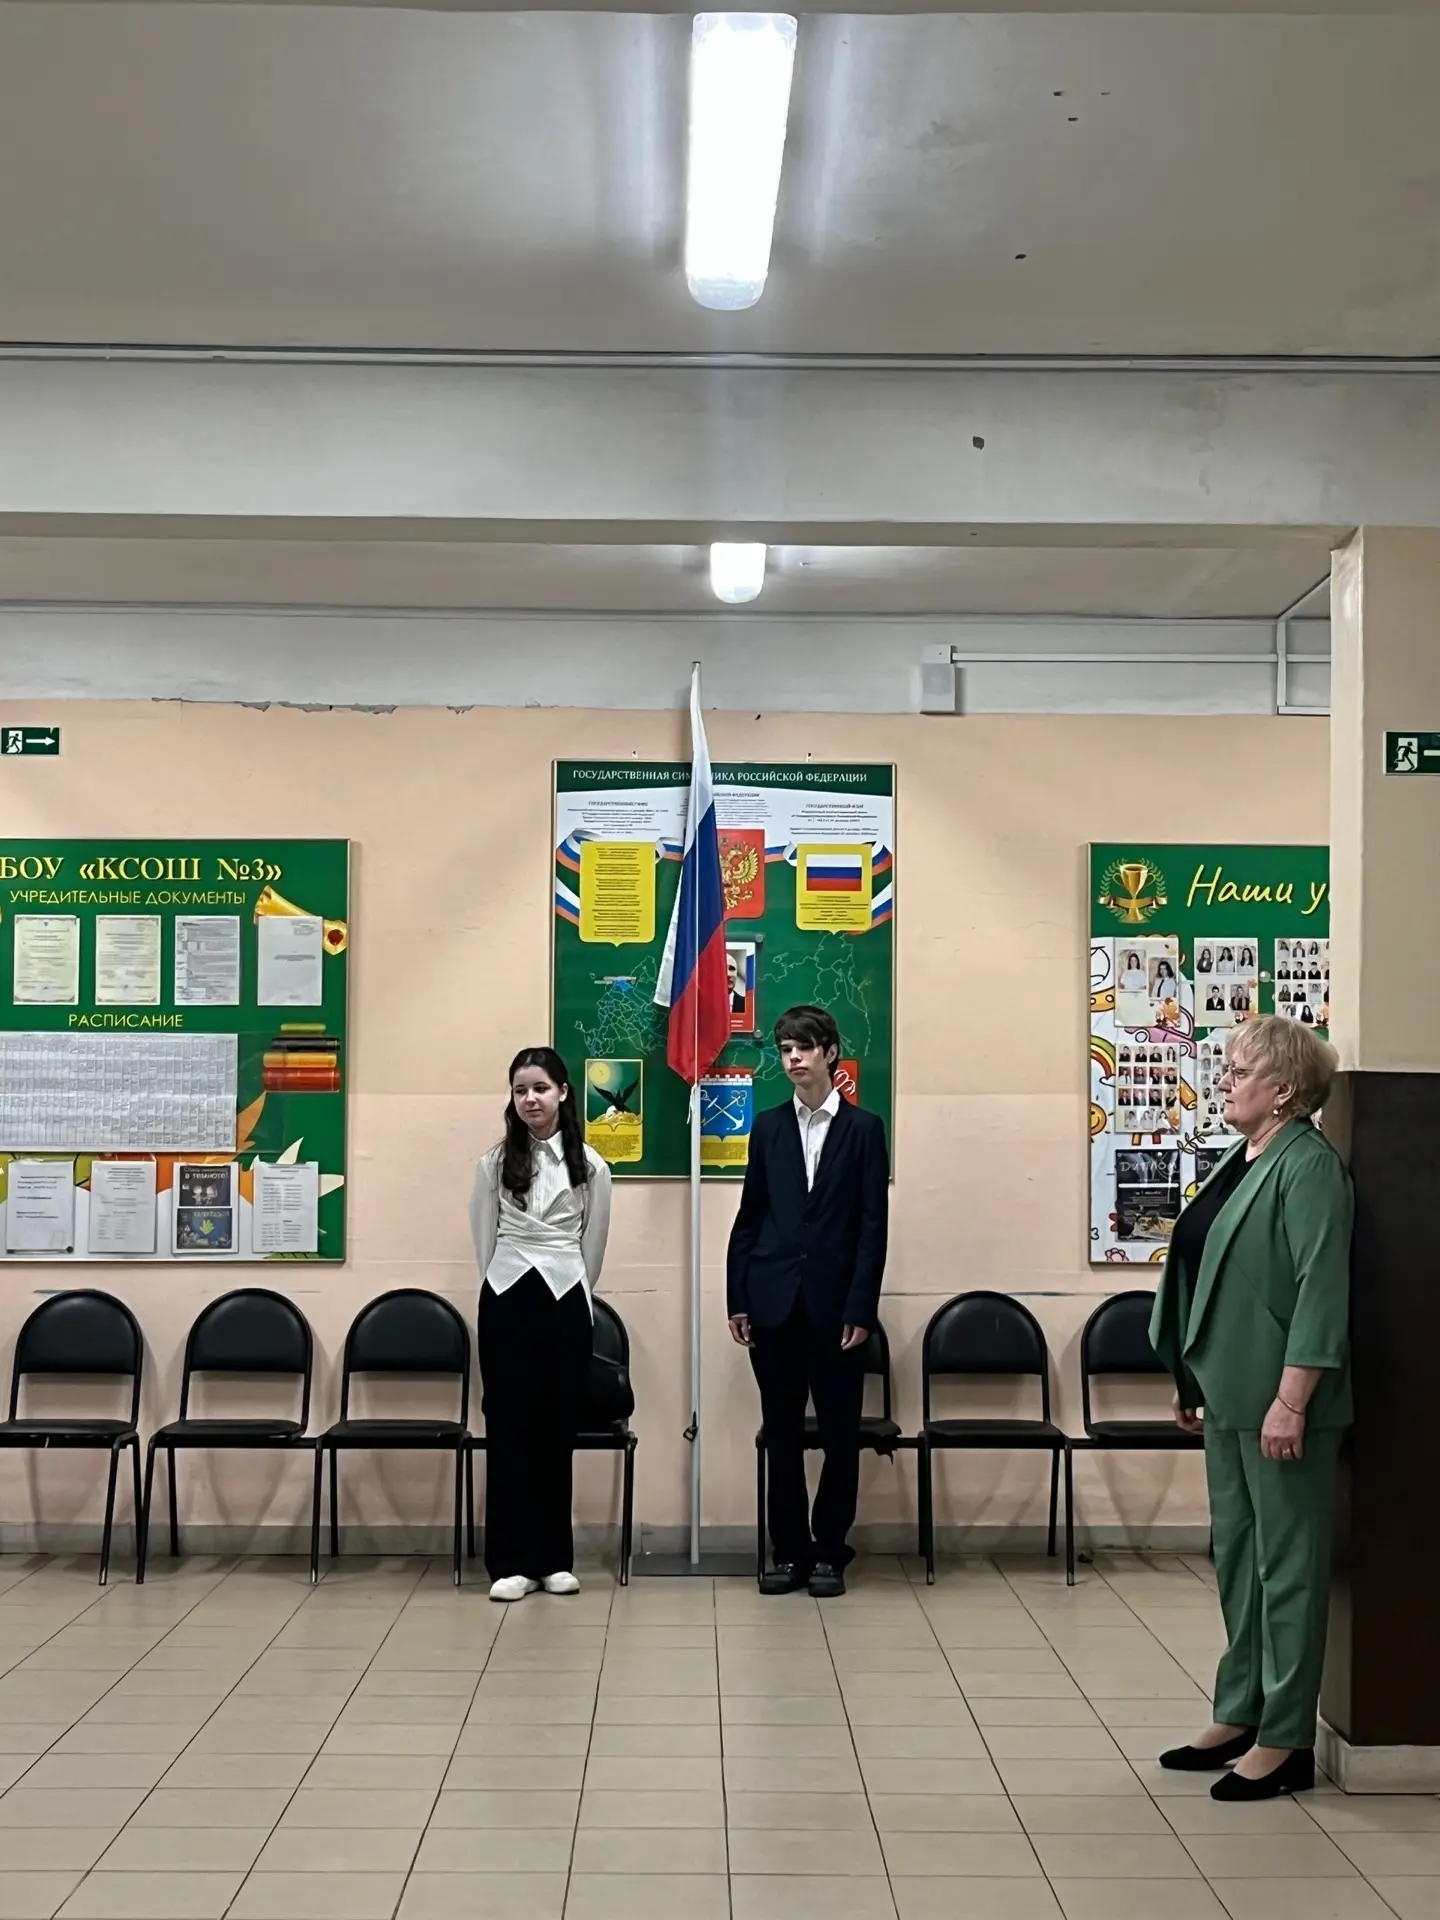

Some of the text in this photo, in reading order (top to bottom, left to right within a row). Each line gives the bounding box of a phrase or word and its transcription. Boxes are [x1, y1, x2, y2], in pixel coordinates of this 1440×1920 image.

[573, 769, 867, 783] ГОСУДАРСТВЕННАЯ СИМИКА РОССИЙСКОЙ ФЕДЕРАЦИИ
[79, 857, 202, 880] «КСОШ
[217, 857, 282, 882] №3»
[1186, 864, 1293, 907] Наши
[10, 889, 246, 905] УЧРЕДИТЕЛЬНЫЕ ДОКУМЕНТЫ
[68, 1013, 184, 1028] РАСПИСАНИЕ
